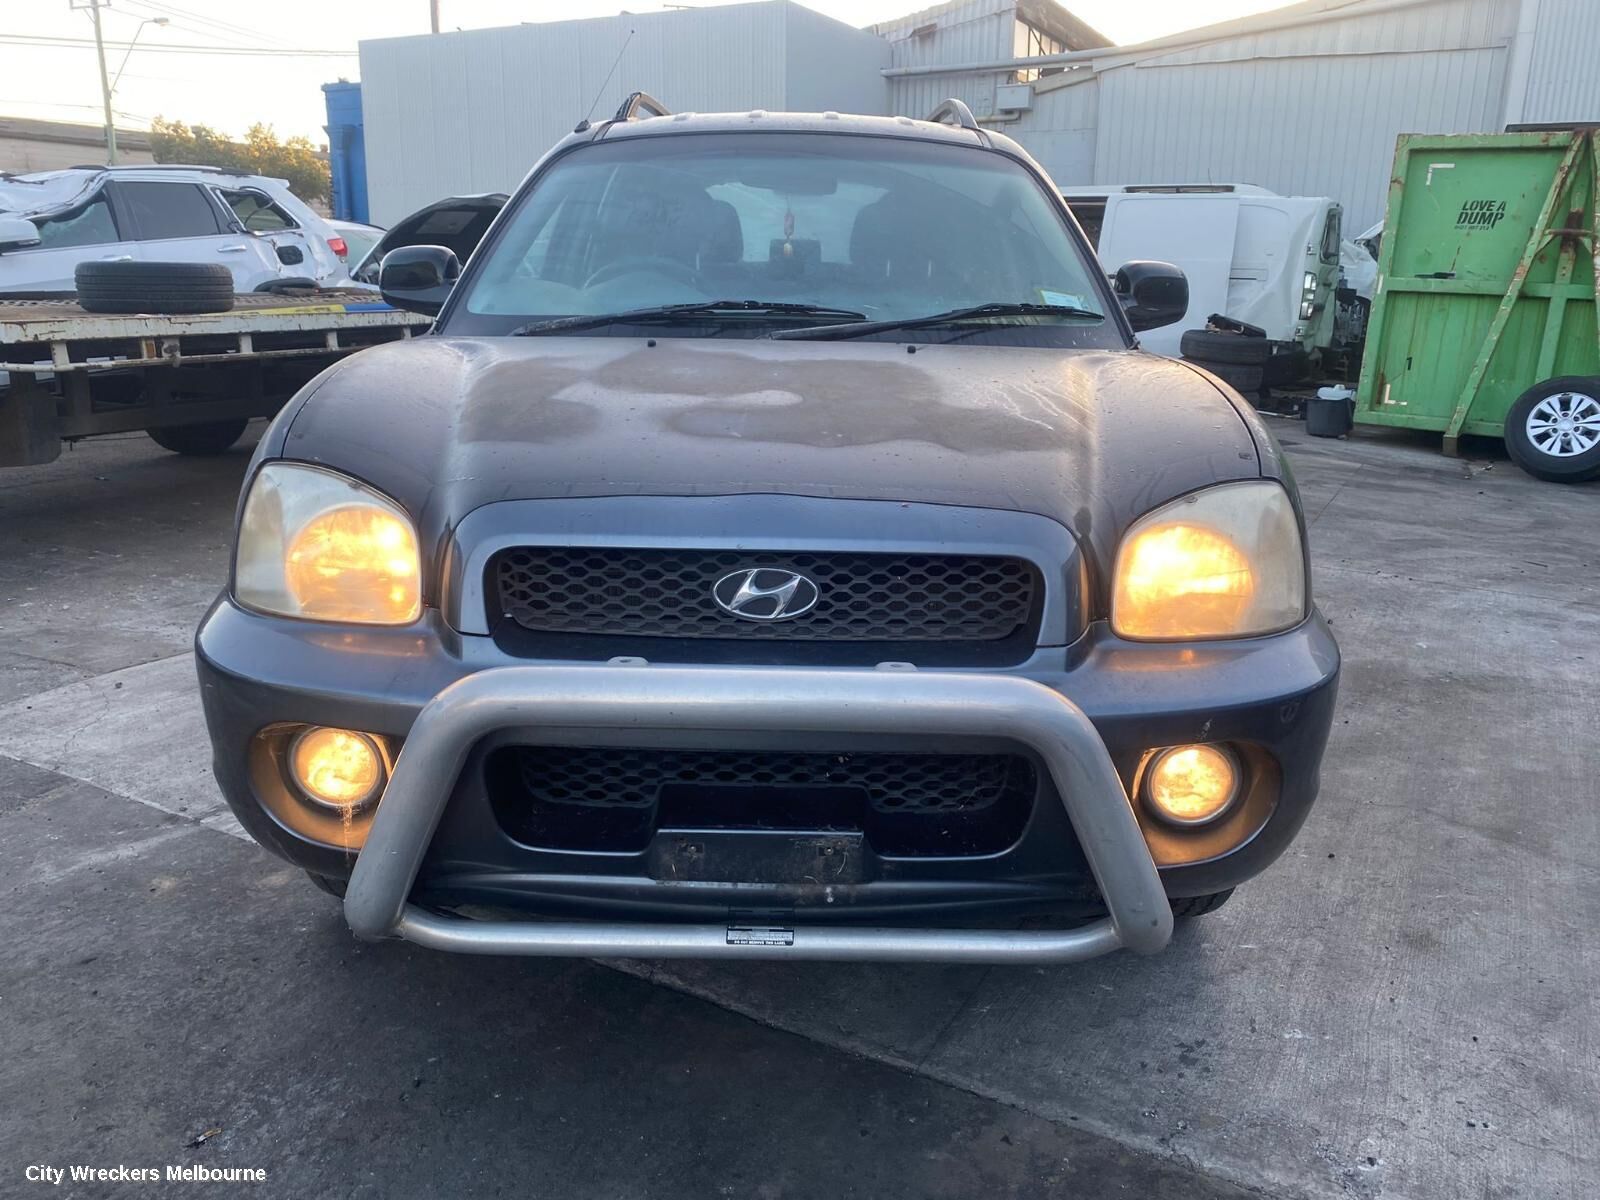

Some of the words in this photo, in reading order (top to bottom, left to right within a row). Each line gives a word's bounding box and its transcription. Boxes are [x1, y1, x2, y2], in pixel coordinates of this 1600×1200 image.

[1462, 199, 1497, 211] LOVE
[1496, 200, 1507, 212] A
[1456, 211, 1505, 230] DUMP
